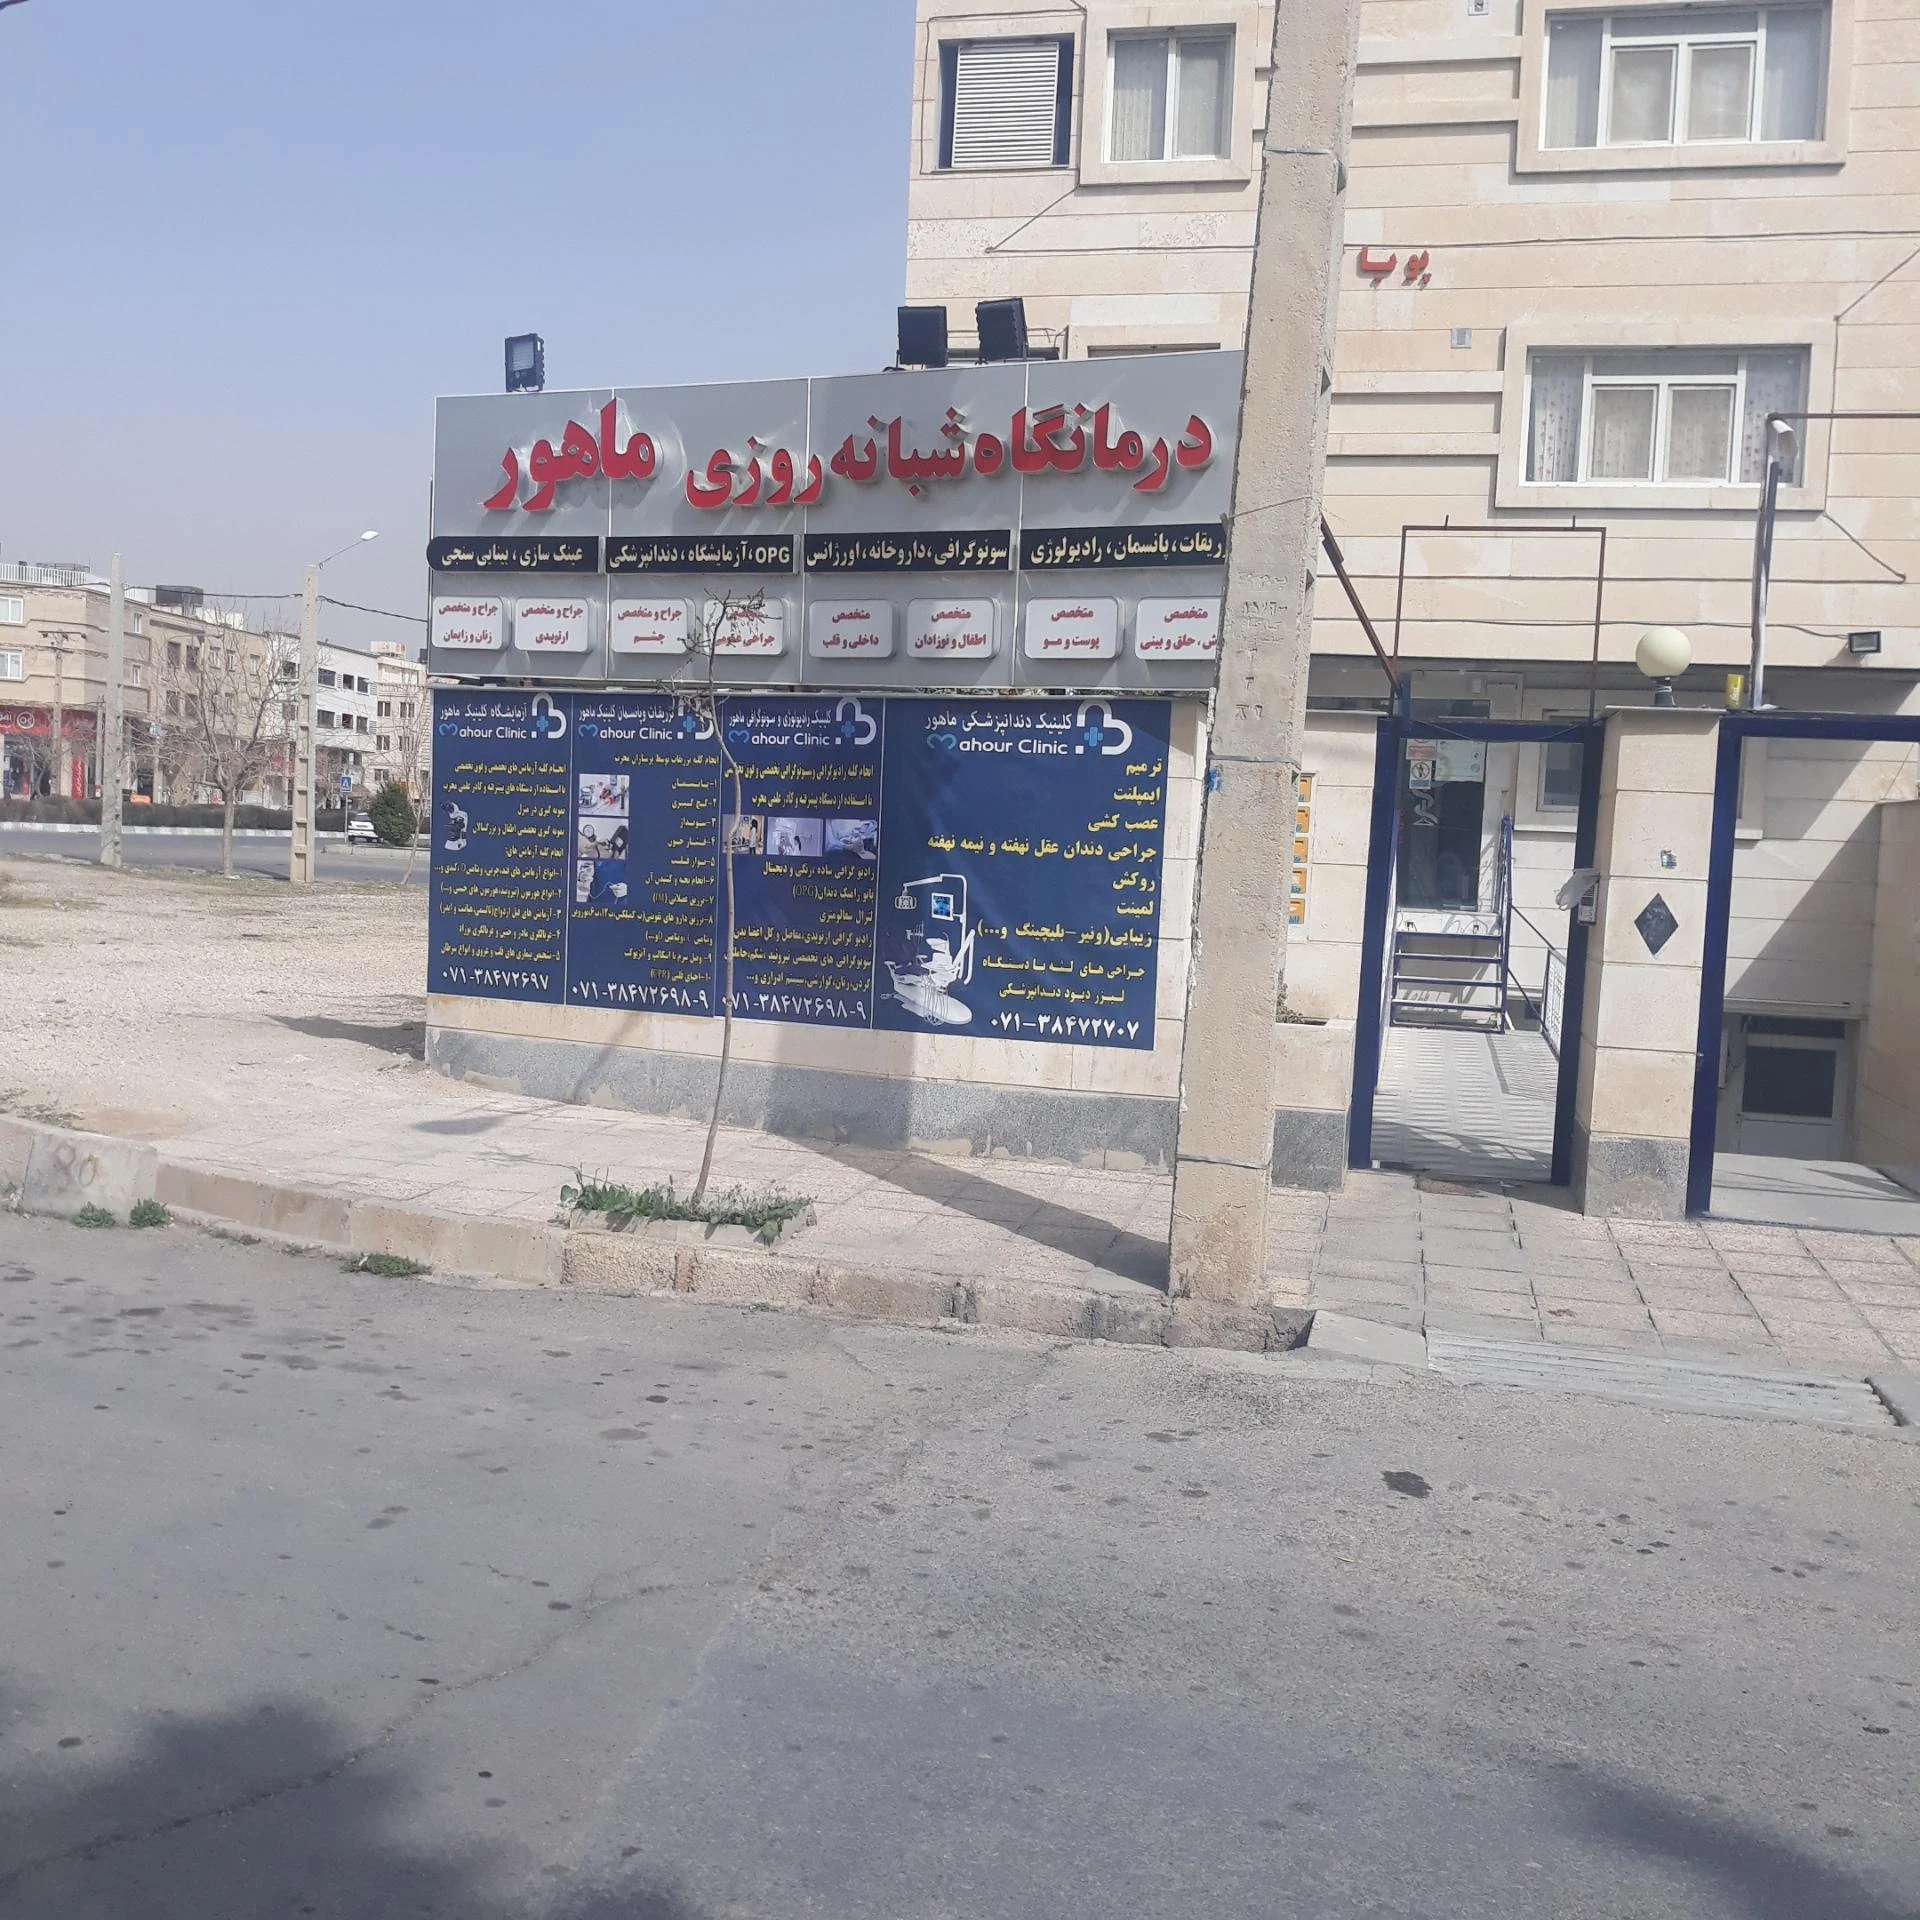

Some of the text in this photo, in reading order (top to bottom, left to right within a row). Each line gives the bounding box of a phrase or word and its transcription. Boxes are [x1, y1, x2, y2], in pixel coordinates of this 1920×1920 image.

[482, 397, 1213, 511] درمانگاه شبانه روزی ماهور
[442, 543, 474, 566] سنجی
[477, 543, 509, 566] بینایی
[554, 543, 583, 566] عینک
[609, 543, 678, 568] دندانپزشکی
[806, 541, 859, 566] اورژانس
[1030, 536, 1101, 564] رادیولوژی
[438, 601, 498, 616] جراح و متخصص
[522, 604, 583, 618] جراح و متخصص
[618, 606, 682, 620] جراح و متخصص
[832, 609, 870, 623] متخصص
[931, 607, 971, 622] متخصص
[1051, 606, 1094, 621] متخصص
[1164, 607, 1208, 623] متخصص
[443, 629, 492, 643] زنان و زایمان
[535, 630, 568, 645] ارتوپدی
[634, 631, 666, 646] چشم
[822, 634, 879, 649] داخلی و قلب
[915, 633, 986, 649] اطفال و نوزادان
[1043, 637, 1100, 650] پوست و مو
[1140, 636, 1163, 650] بینی
[1166, 639, 1172, 649] و
[1173, 634, 1195, 650] حلق
[440, 702, 527, 722] آزمایشگاه کلینیک ماهور
[579, 704, 595, 721] ماهور
[925, 710, 1073, 737] کلینیک دندانپزشکی ماهور
[496, 726, 527, 738] Clinic
[640, 728, 672, 740] Clinic
[794, 733, 830, 745] Clinic
[1018, 739, 1069, 755] Clinic
[1126, 758, 1163, 777] ترمیم
[1113, 785, 1161, 806] ایمپلنت
[1087, 813, 1159, 832] عصب کشی
[928, 834, 1157, 863] جراحی دندان عقل نهفته و نیمه نهفته
[1112, 871, 1156, 892] روکش
[1117, 900, 1154, 919] لمینت
[982, 955, 1145, 979] جراحی های لثه با دستگاه
[999, 981, 1125, 1005] لیزر دیود دندانپزشکی
